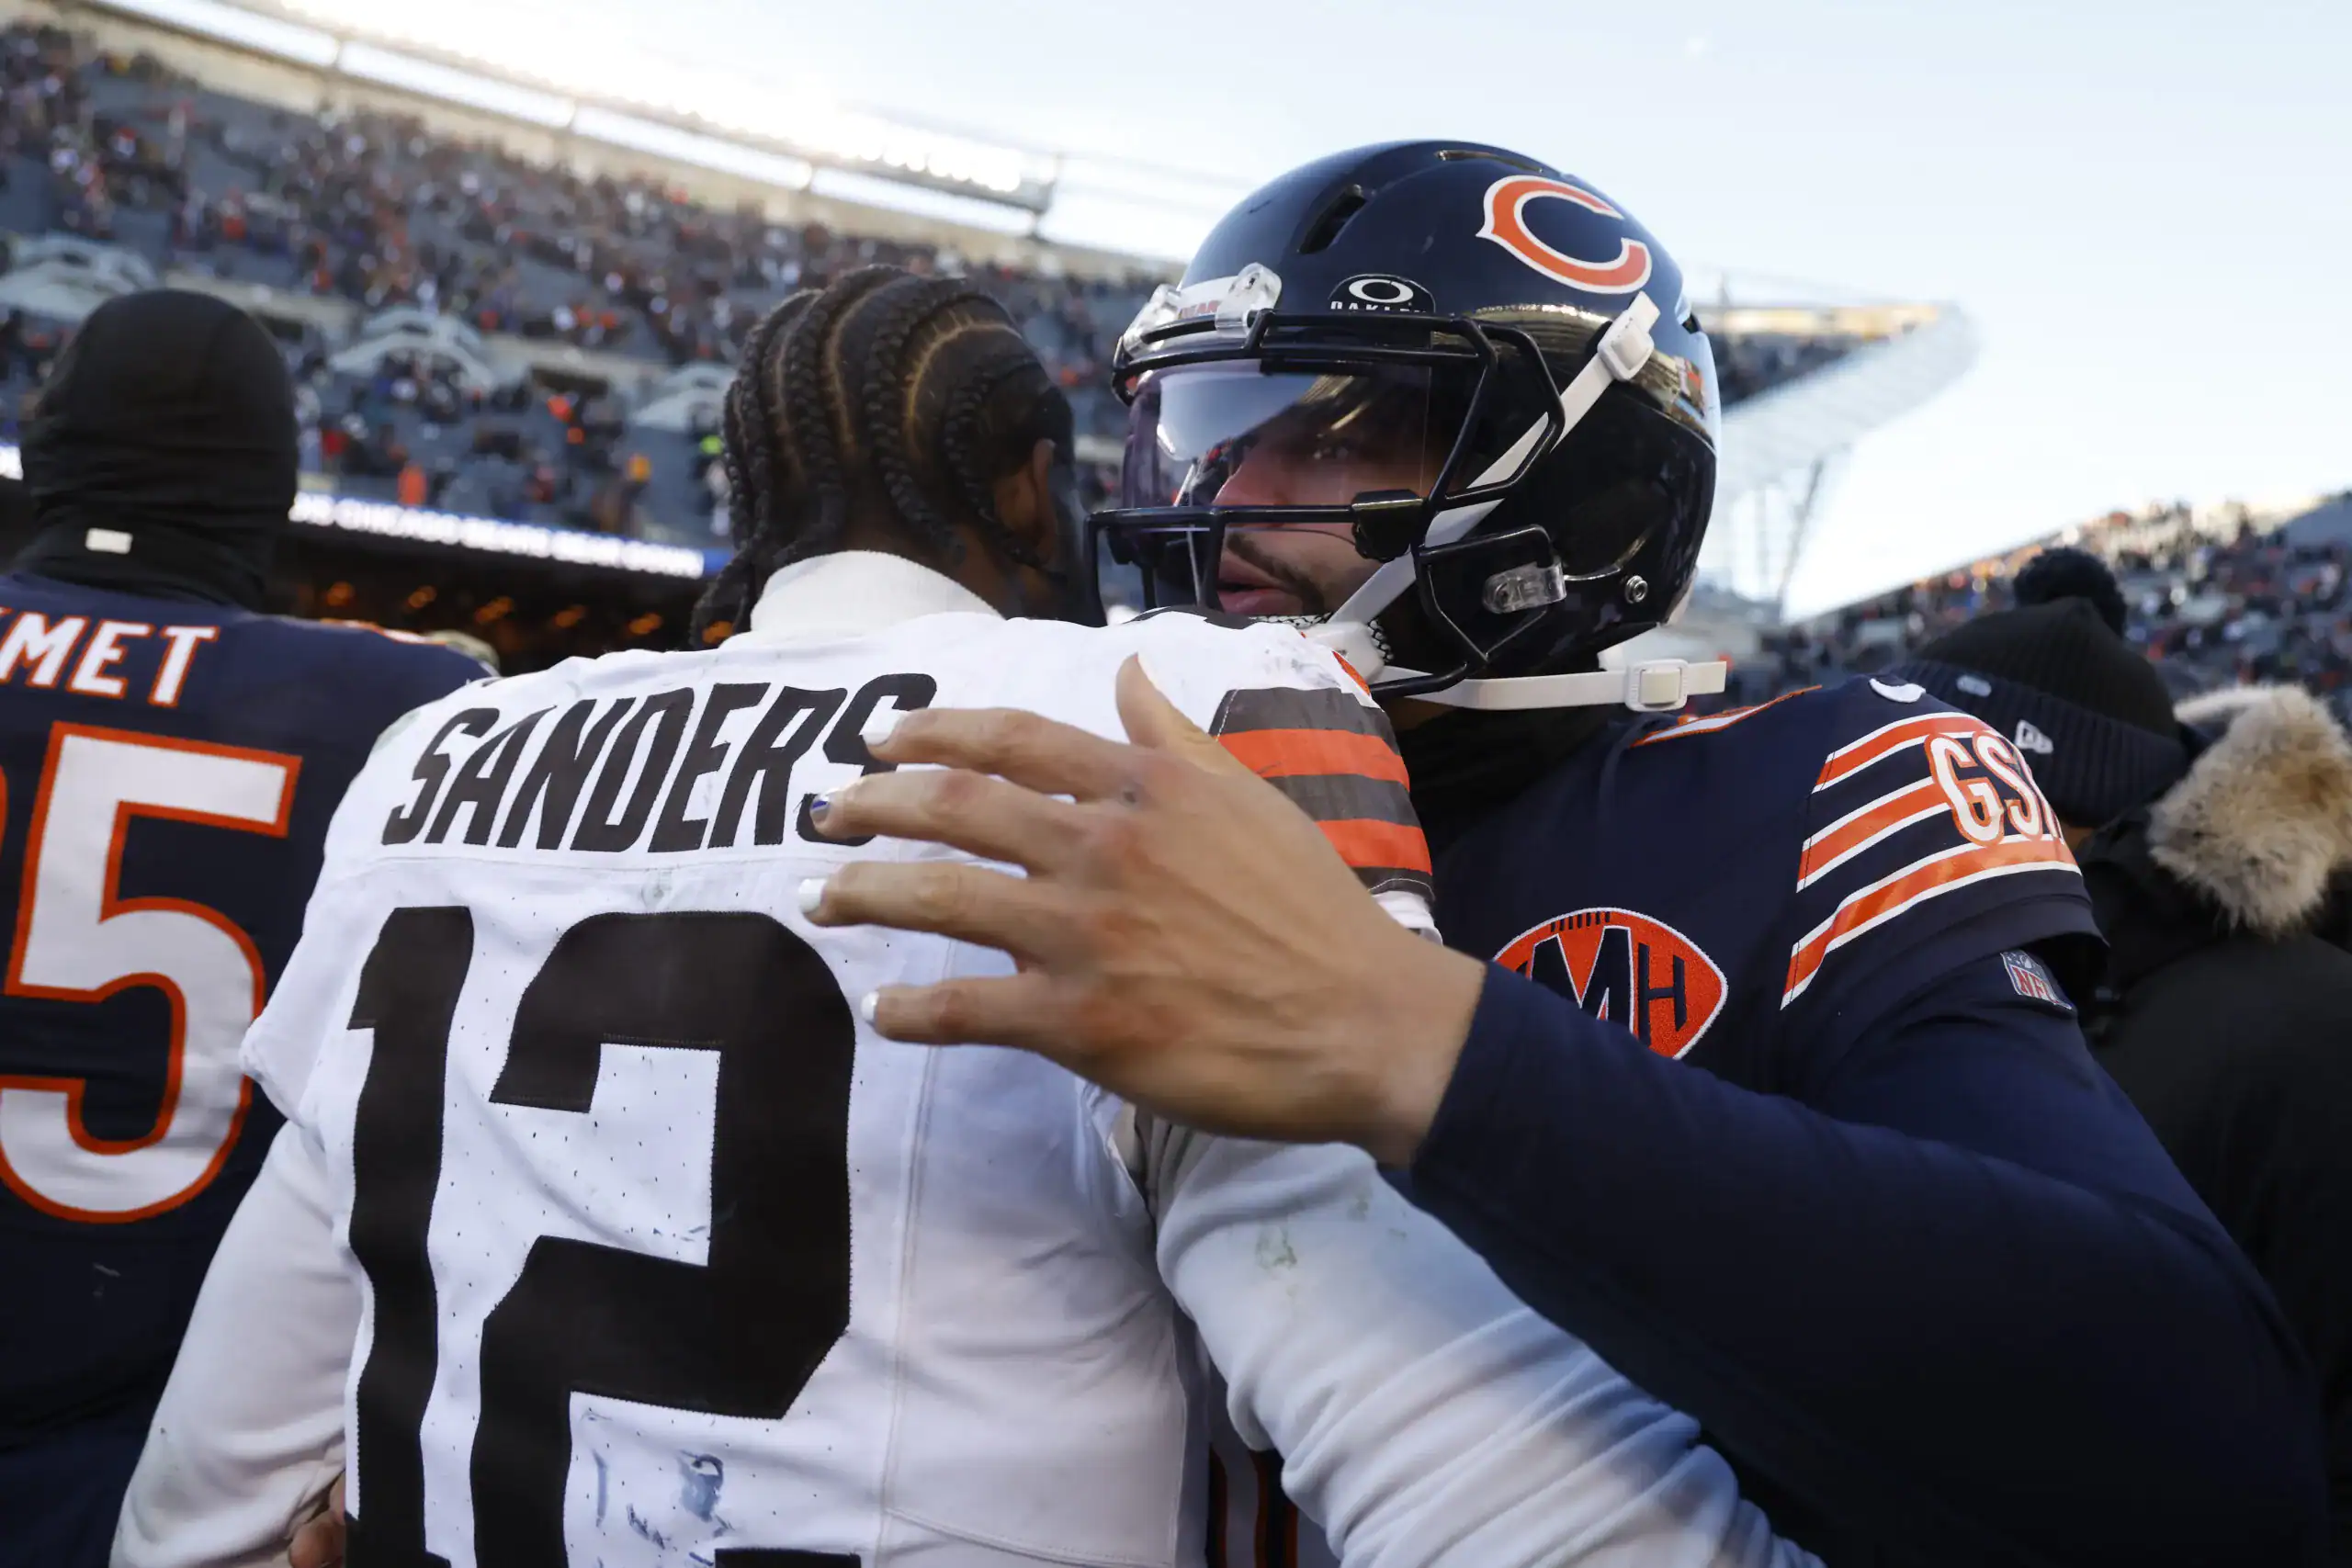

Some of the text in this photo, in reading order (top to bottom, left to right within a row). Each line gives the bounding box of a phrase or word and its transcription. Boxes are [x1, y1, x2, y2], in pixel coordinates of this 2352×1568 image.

[1476, 175, 1652, 294] C
[1330, 300, 1427, 313] OAK
[0, 606, 220, 707] MET
[381, 673, 938, 853] SANDERS
[1924, 730, 2066, 847] GS
[0, 721, 302, 1224] 5
[1515, 925, 1688, 1048] MH
[345, 905, 860, 1568] 12
